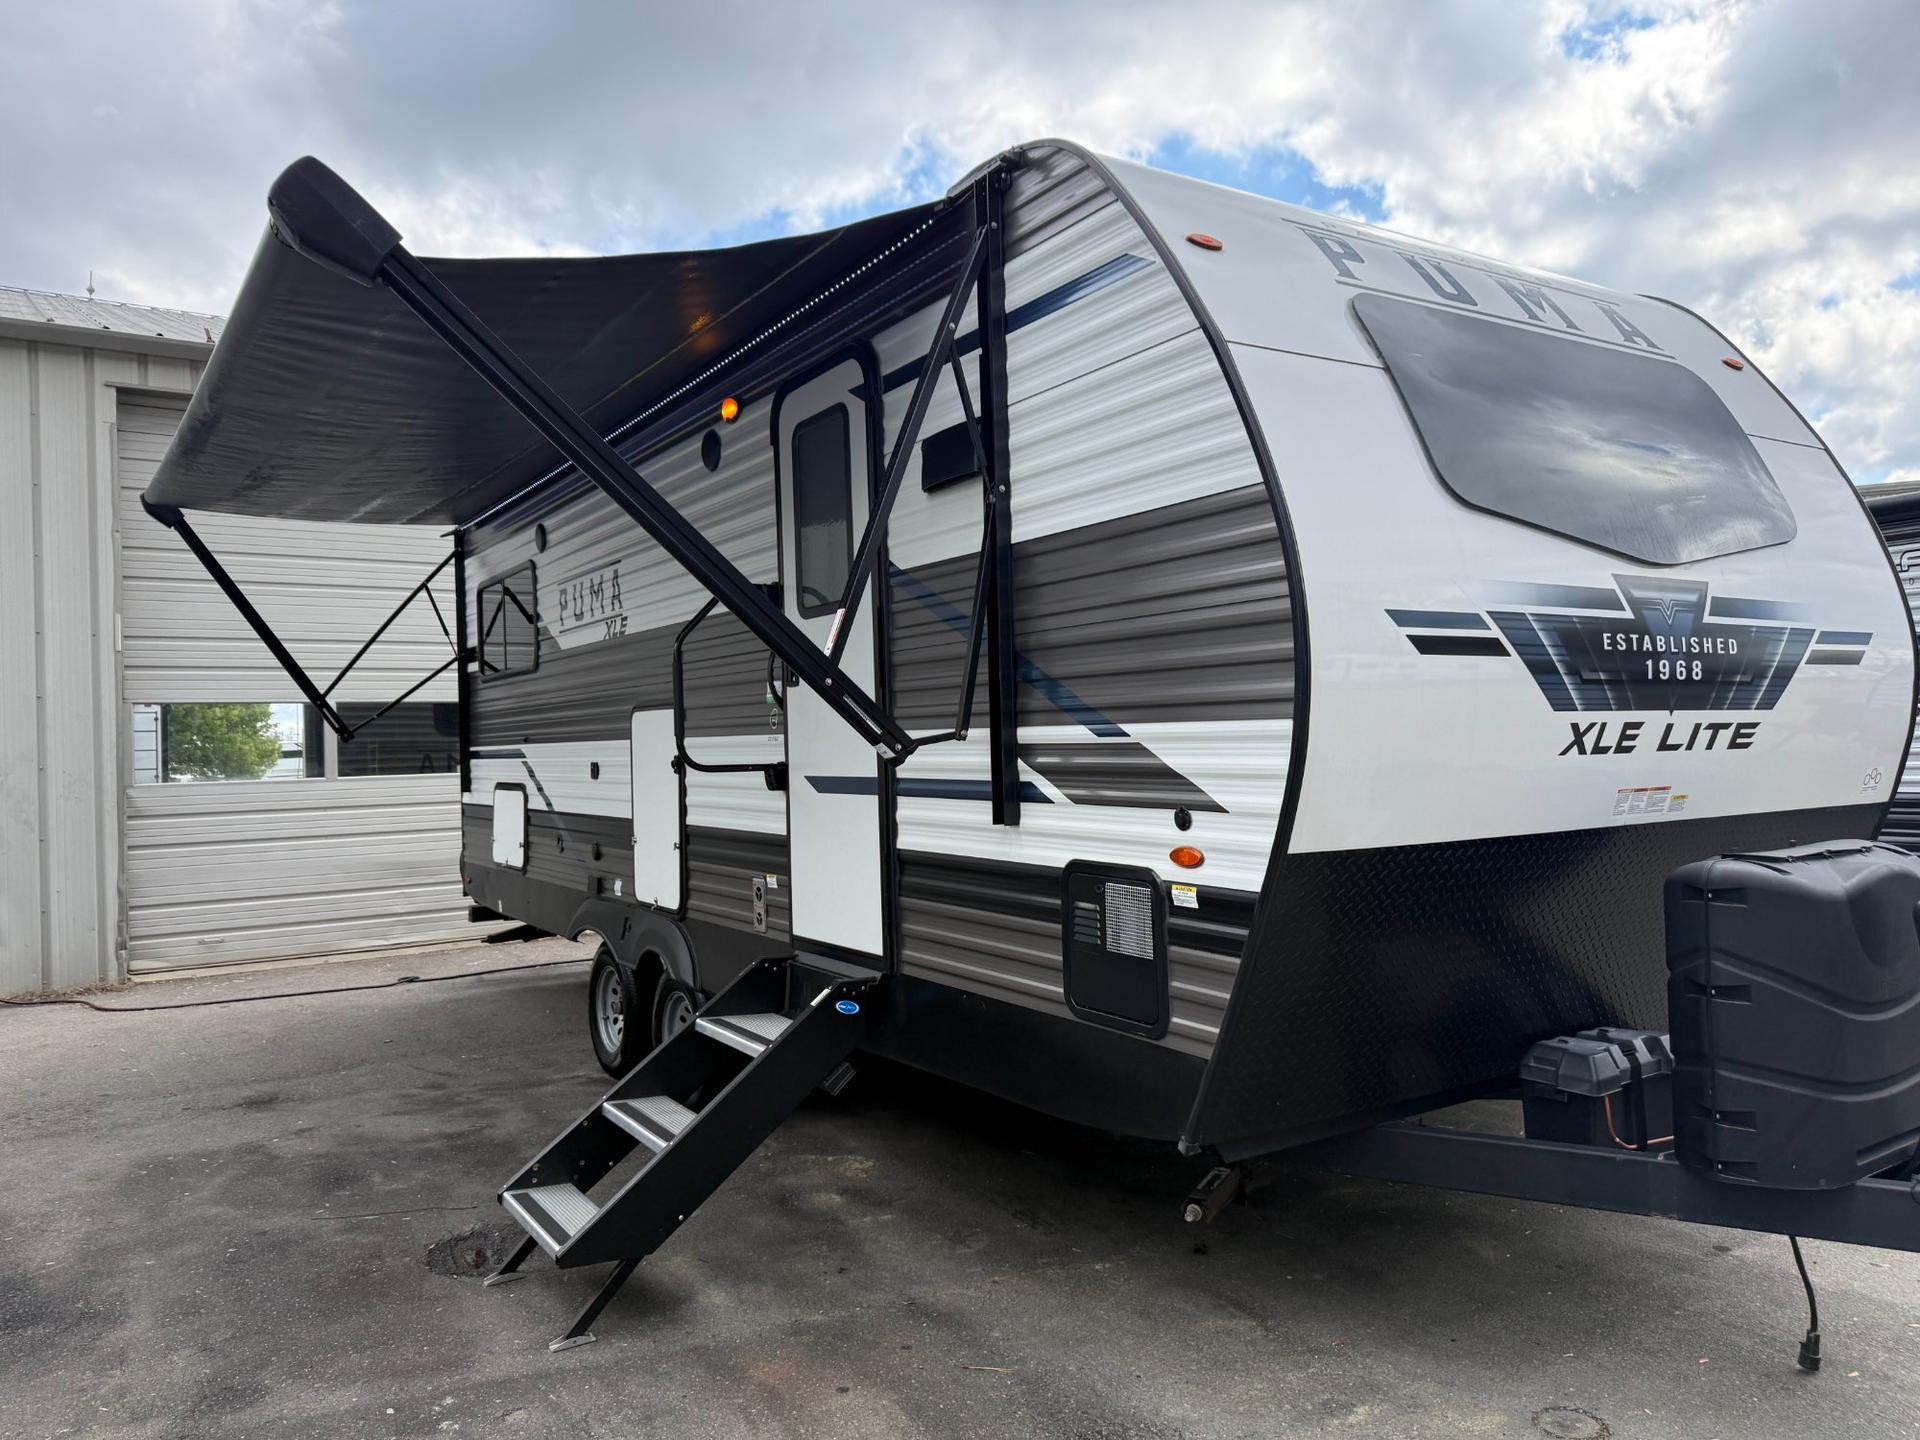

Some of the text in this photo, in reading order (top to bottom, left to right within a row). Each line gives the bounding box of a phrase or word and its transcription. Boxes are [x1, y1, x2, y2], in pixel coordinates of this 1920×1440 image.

[1295, 225, 1665, 351] PUMA
[560, 567, 623, 626] PUMA
[603, 616, 628, 641] XLE
[1602, 632, 1738, 655] ESTABLISHED
[1645, 659, 1702, 680] 1968
[1558, 721, 1762, 756] XLE LITE
